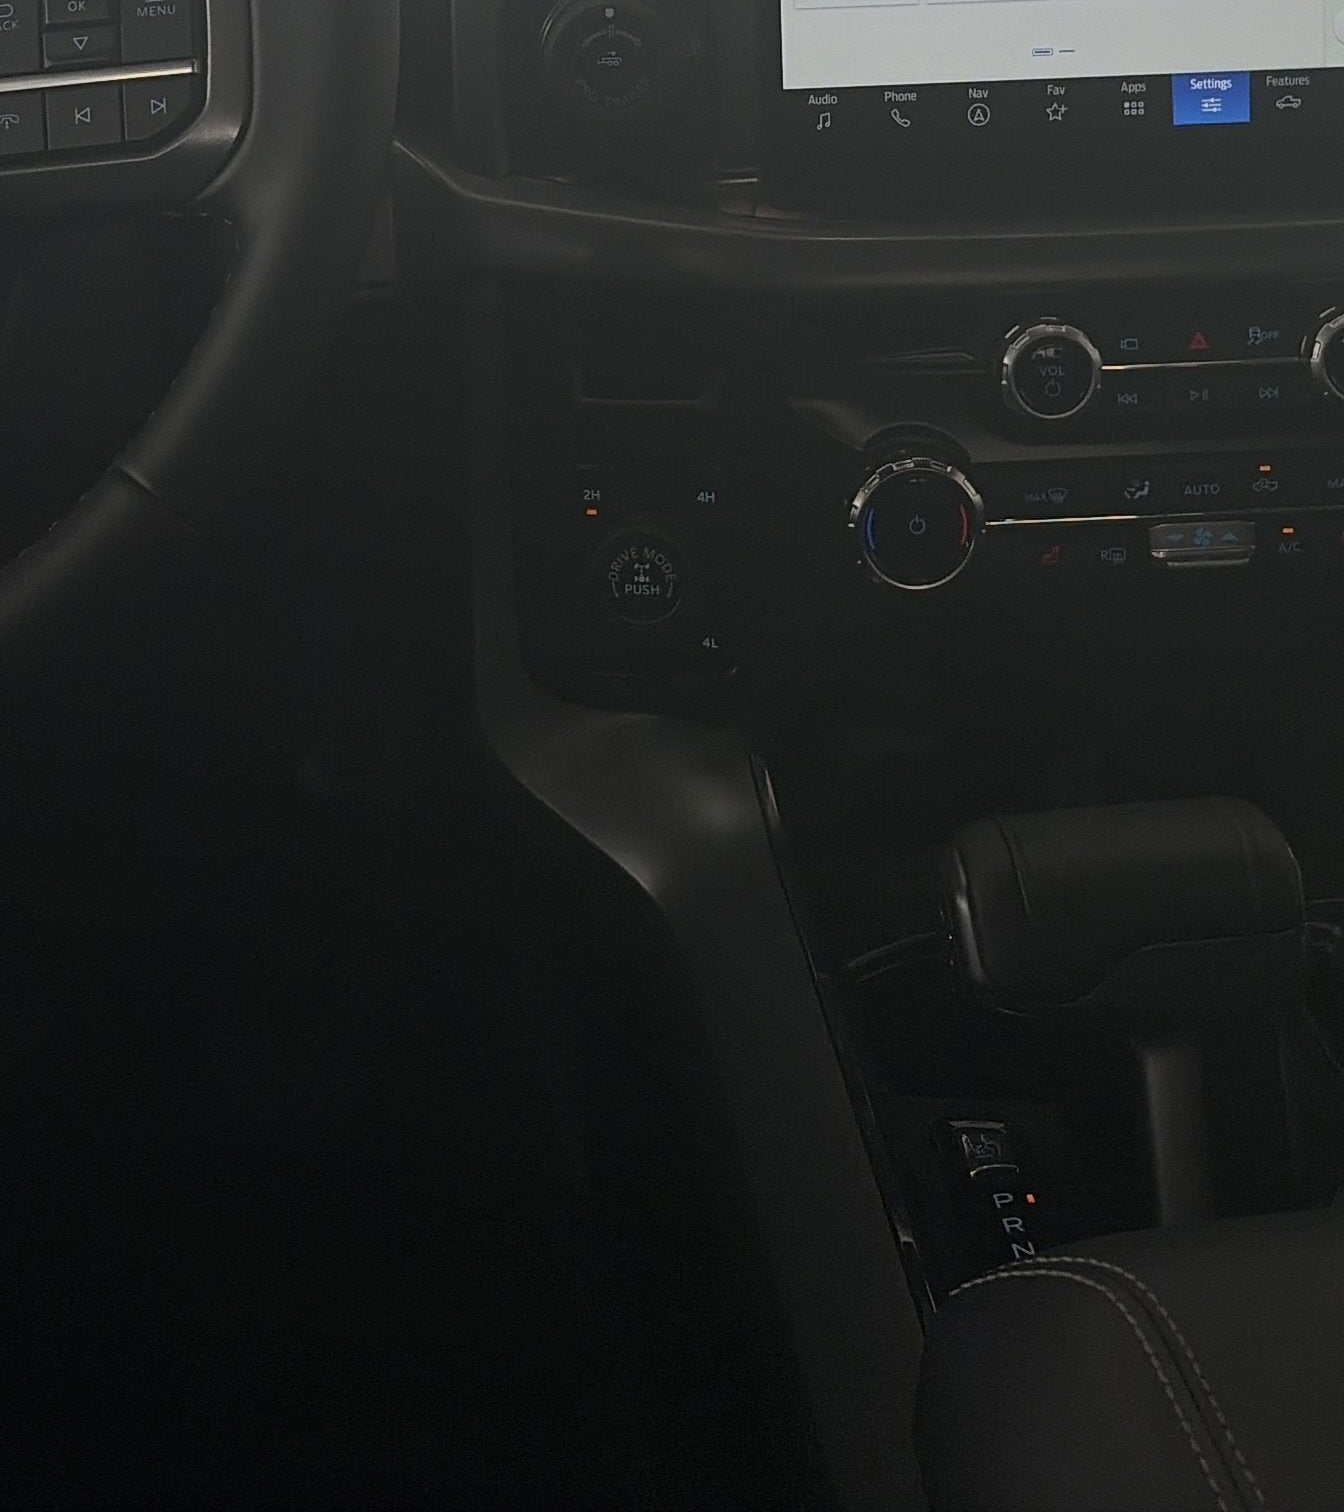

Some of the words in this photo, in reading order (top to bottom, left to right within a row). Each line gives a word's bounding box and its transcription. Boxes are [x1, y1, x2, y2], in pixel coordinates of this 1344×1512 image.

[67, 0, 87, 13] OK
[136, 4, 177, 18] MENU
[1120, 81, 1147, 94] Apps
[1190, 77, 1232, 91] Settings
[1266, 74, 1310, 88] Features
[884, 90, 918, 103] Phone
[968, 88, 989, 99] Nav
[1047, 85, 1066, 96] Fav
[807, 93, 838, 106] Audio
[1038, 364, 1066, 377] VOL
[582, 489, 602, 502] 2H
[1183, 483, 1220, 496] AUTO
[696, 490, 716, 504] 4H
[624, 583, 661, 596] PUSH
[701, 637, 720, 649] 4L
[991, 1191, 1015, 1210] P
[1001, 1215, 1026, 1235] R
[1010, 1240, 1037, 1260] N
